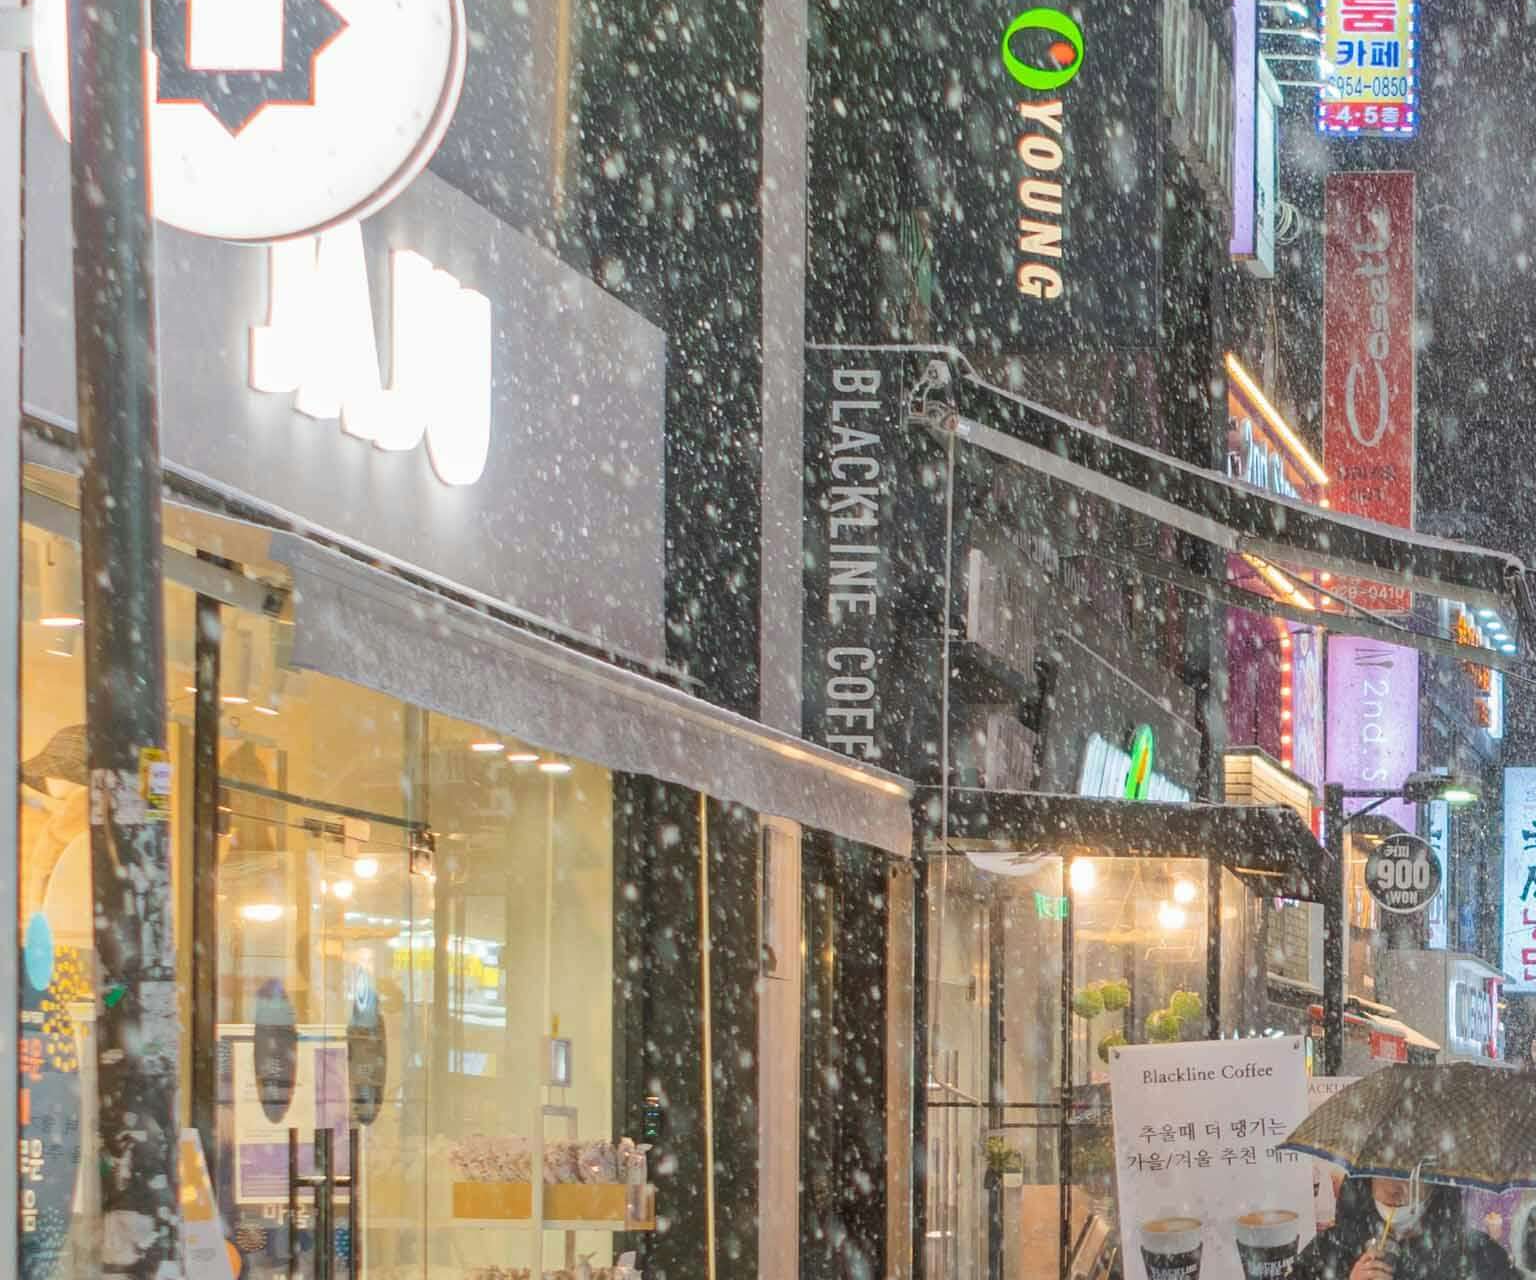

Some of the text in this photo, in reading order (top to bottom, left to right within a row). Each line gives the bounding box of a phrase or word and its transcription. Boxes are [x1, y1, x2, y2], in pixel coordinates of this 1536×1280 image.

[1336, 40, 1400, 68] 카페
[1017, 100, 1064, 301] YOUNG
[827, 368, 881, 617] BLACKLINE
[1377, 860, 1430, 890] 900
[1143, 1063, 1273, 1085] Blackline Coffee
[1138, 1118, 1287, 1145] 추울때 더 땡기는
[1220, 1146, 1257, 1166] 추천
